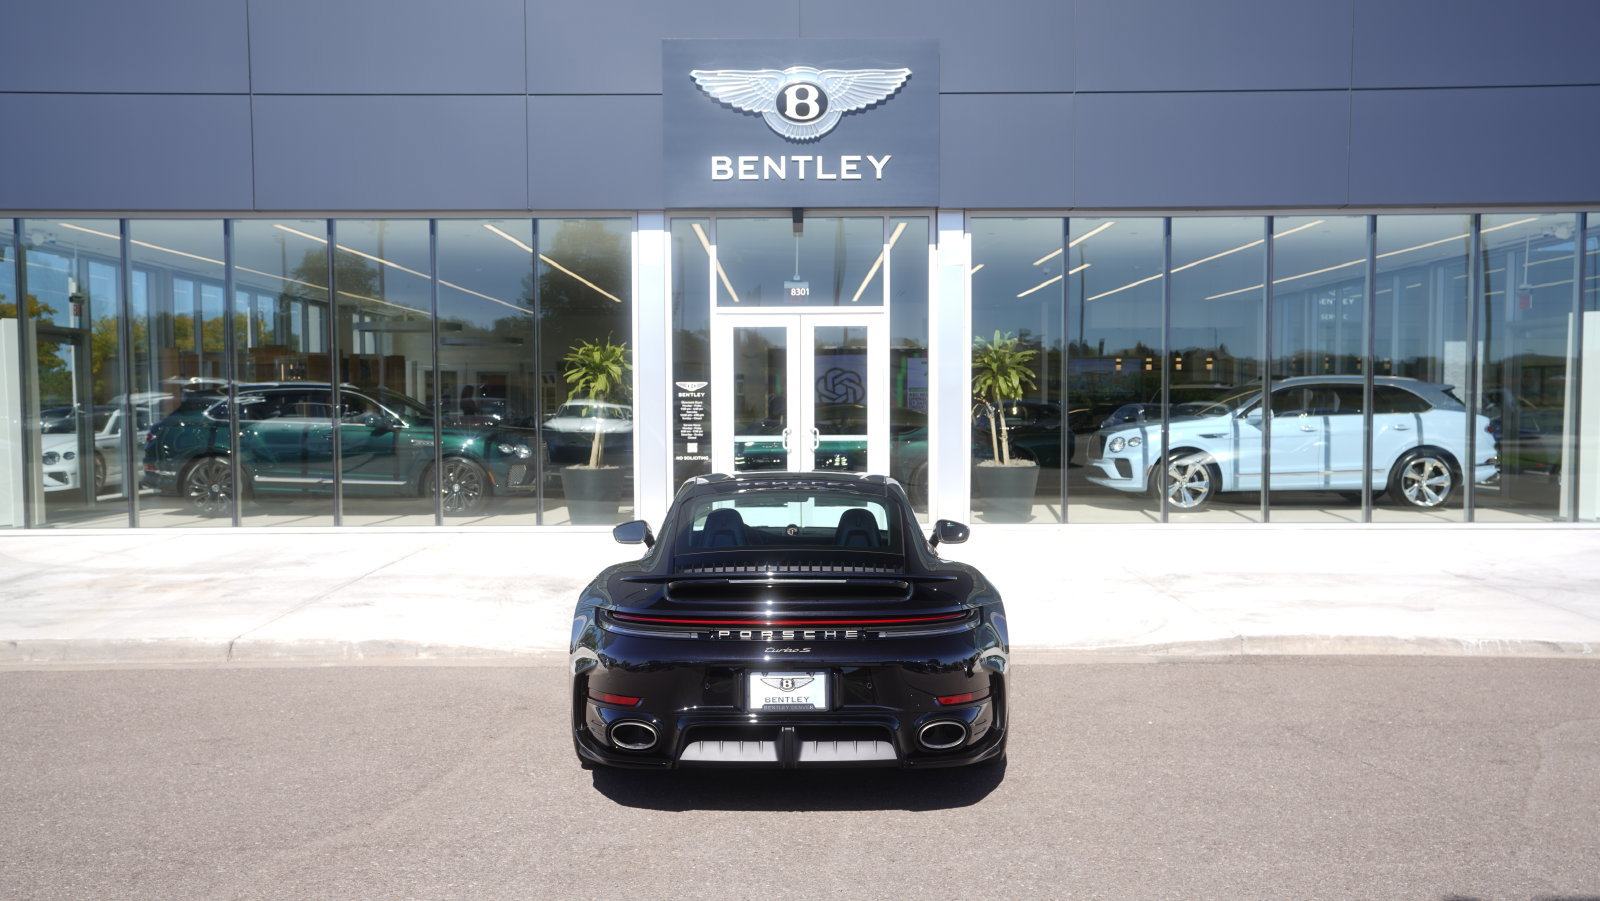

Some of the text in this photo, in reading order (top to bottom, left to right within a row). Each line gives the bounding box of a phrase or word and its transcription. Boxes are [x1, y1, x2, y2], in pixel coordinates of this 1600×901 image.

[784, 84, 820, 120] B
[711, 155, 892, 180] BENTLEY
[790, 287, 810, 296] 8301
[718, 630, 858, 640] PORSCHE
